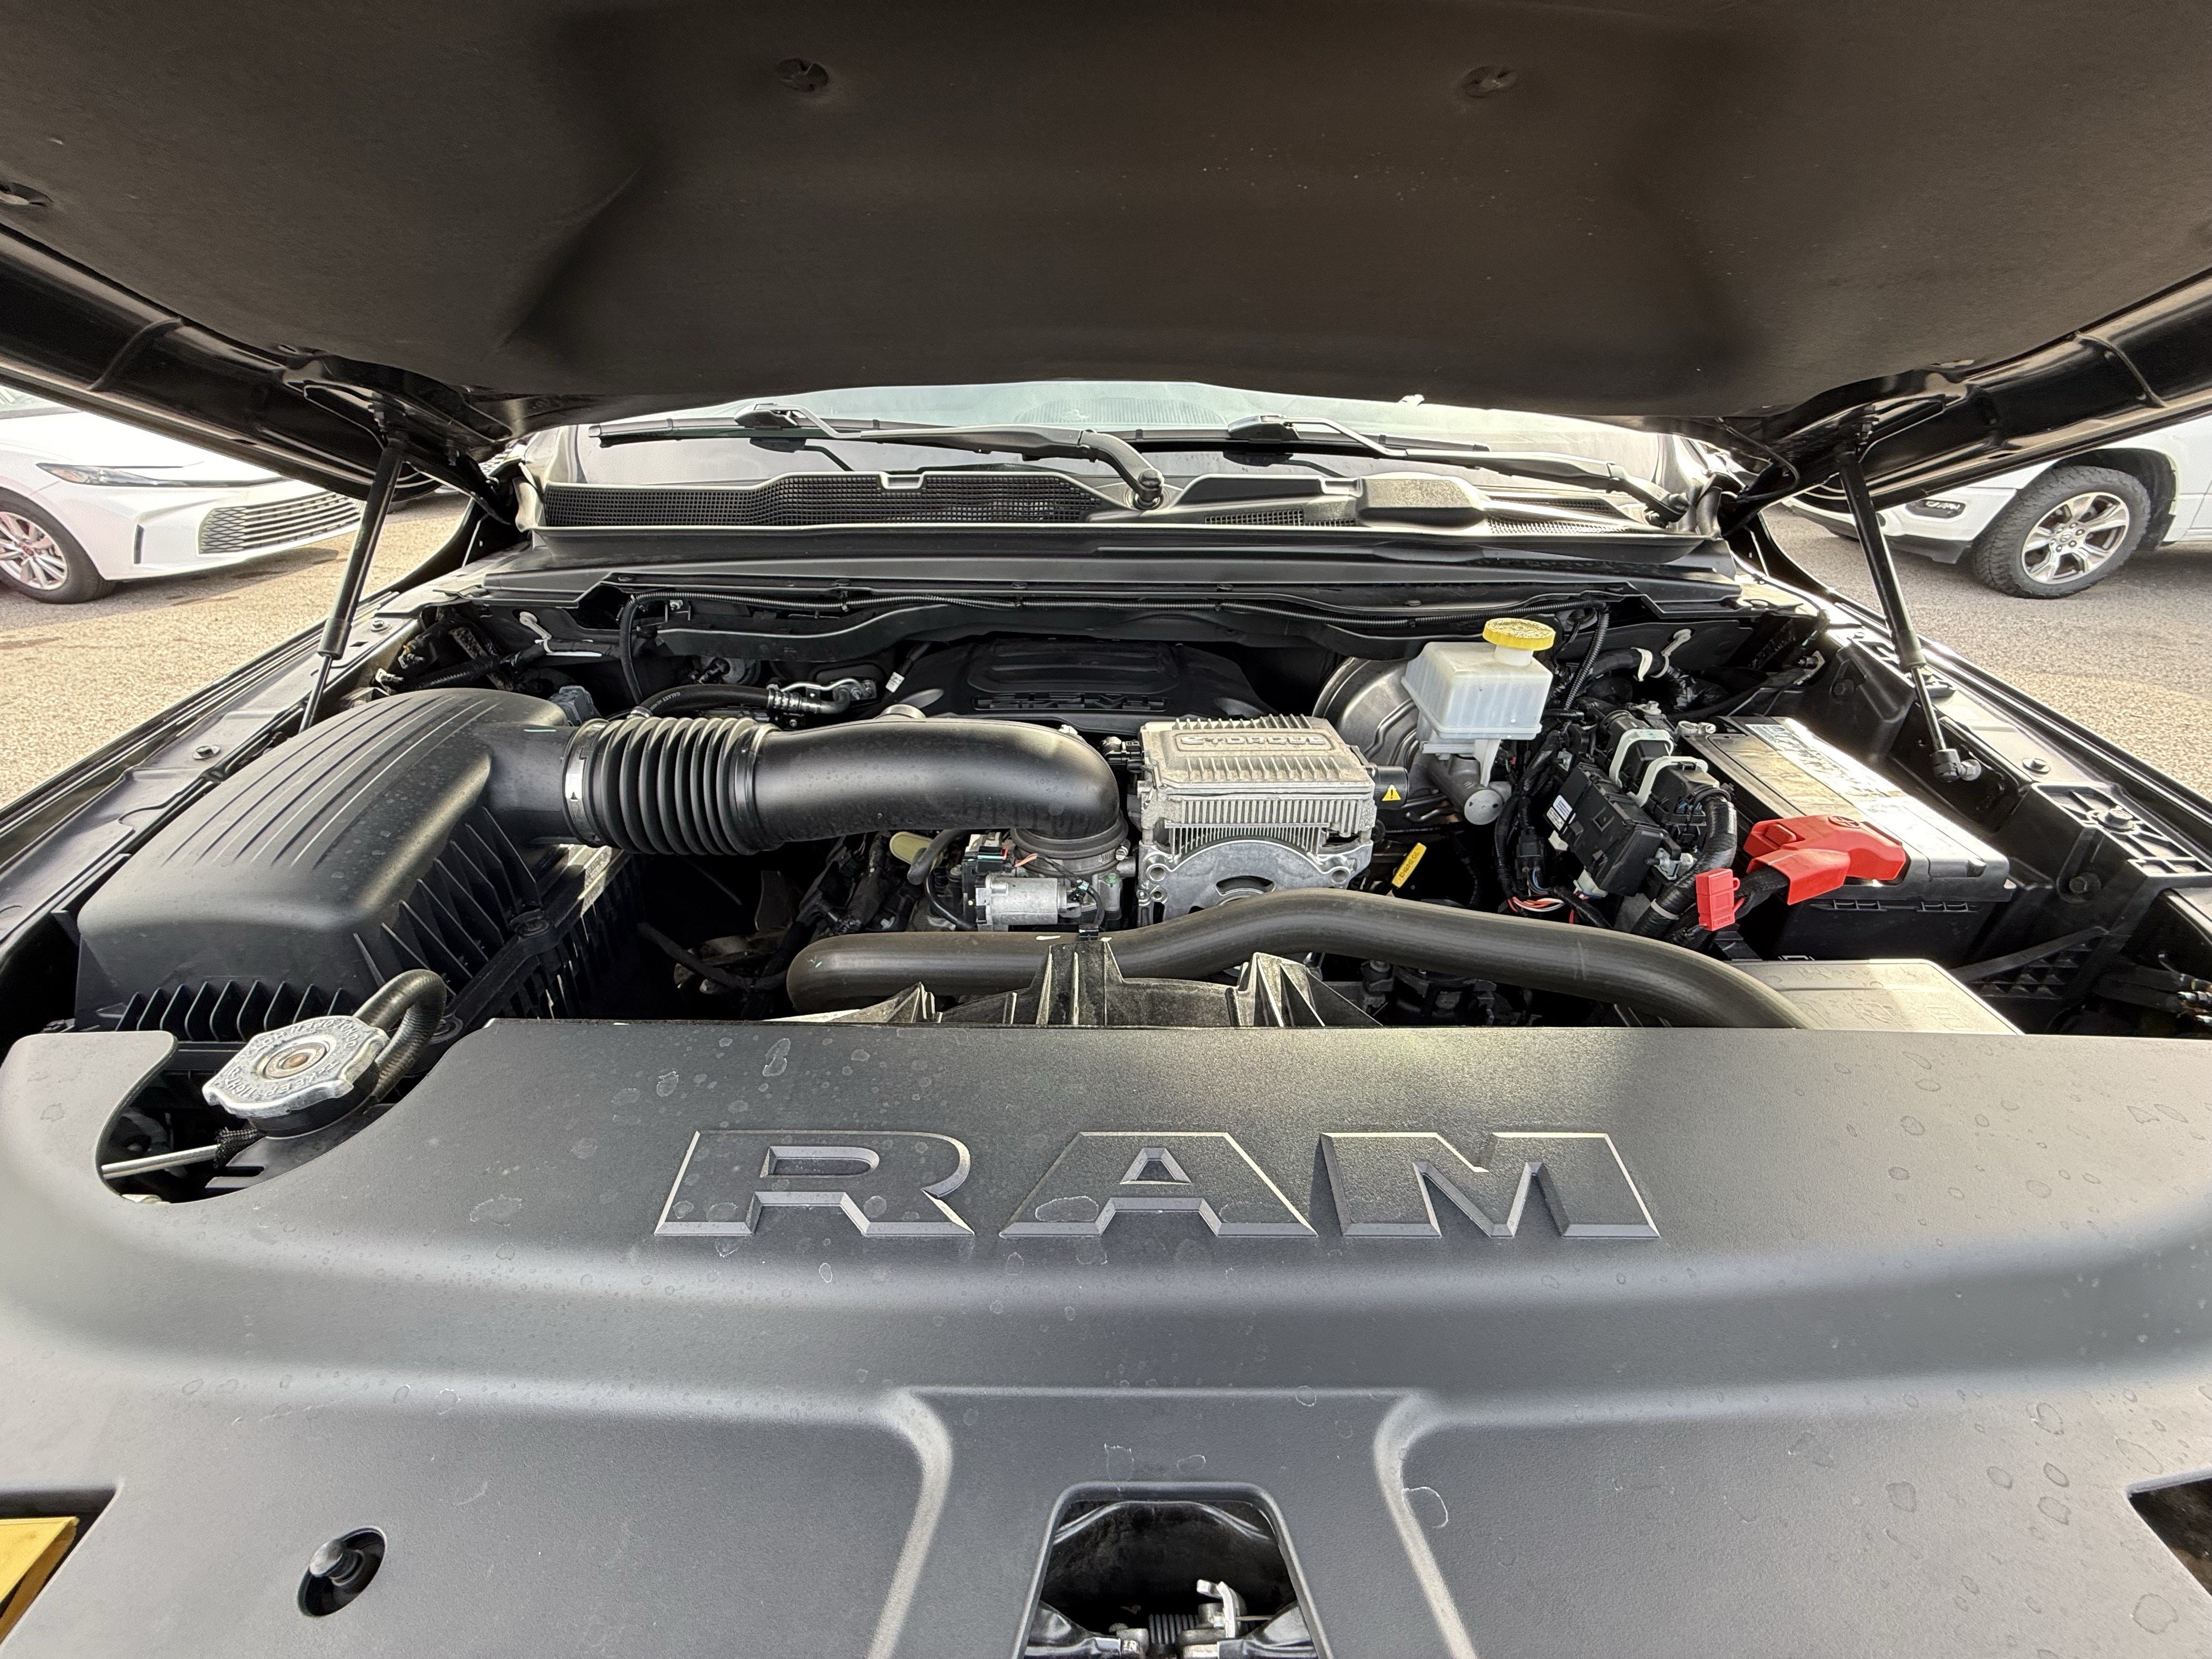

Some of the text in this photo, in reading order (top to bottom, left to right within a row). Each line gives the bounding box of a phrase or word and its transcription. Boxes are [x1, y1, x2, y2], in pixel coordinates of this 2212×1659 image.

[291, 1019, 335, 1035] OPEN
[335, 1020, 358, 1037] NOT
[252, 1032, 287, 1052] HOT
[264, 1072, 318, 1097] KEEP
[654, 1130, 1661, 1238] RAM
